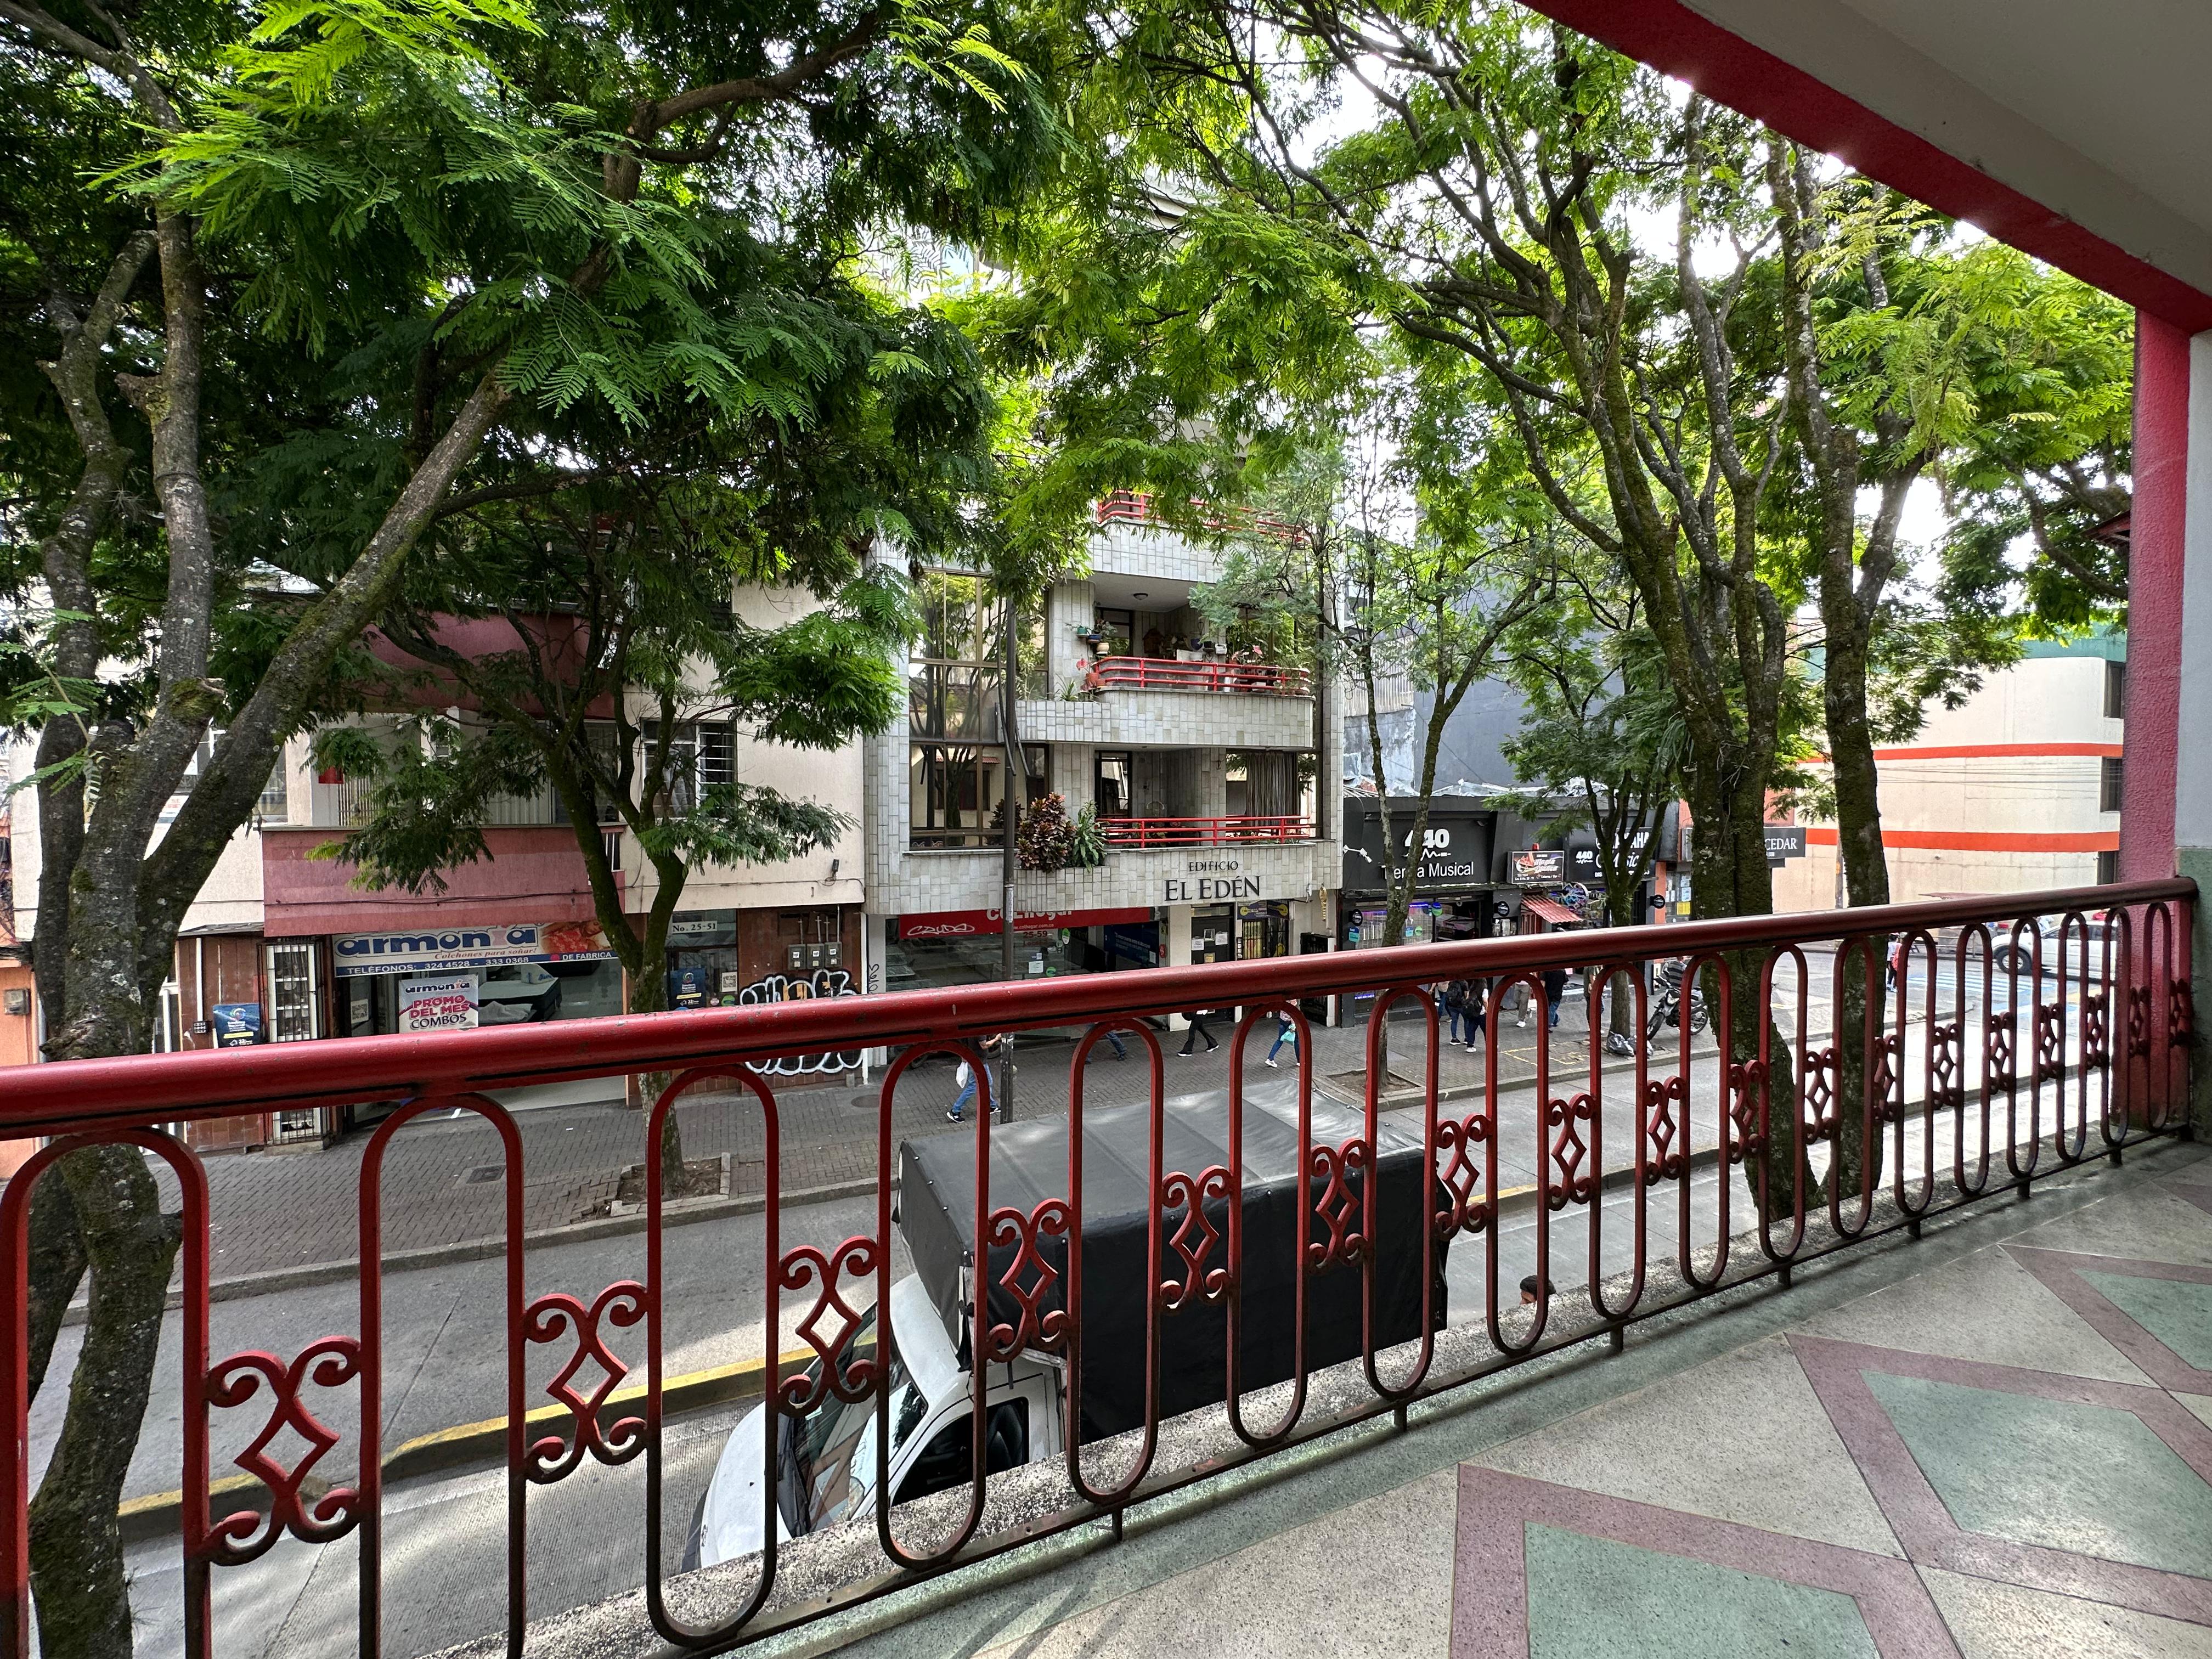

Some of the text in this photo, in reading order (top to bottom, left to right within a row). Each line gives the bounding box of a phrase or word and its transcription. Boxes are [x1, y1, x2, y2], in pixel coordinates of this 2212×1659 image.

[1188, 861, 1239, 871] EDIFICIO
[1429, 861, 1474, 878] Musical
[1164, 876, 1261, 901] EL EDÉN
[691, 923, 716, 931] 25-51
[347, 964, 416, 974] TELÉFONOS:
[445, 961, 470, 969] 4528
[576, 951, 612, 960] FABRICA
[435, 951, 482, 960] Colchones
[413, 995, 466, 1009] PROMO
[410, 1003, 470, 1019] DEL MES
[411, 1013, 467, 1029] COMBOS
